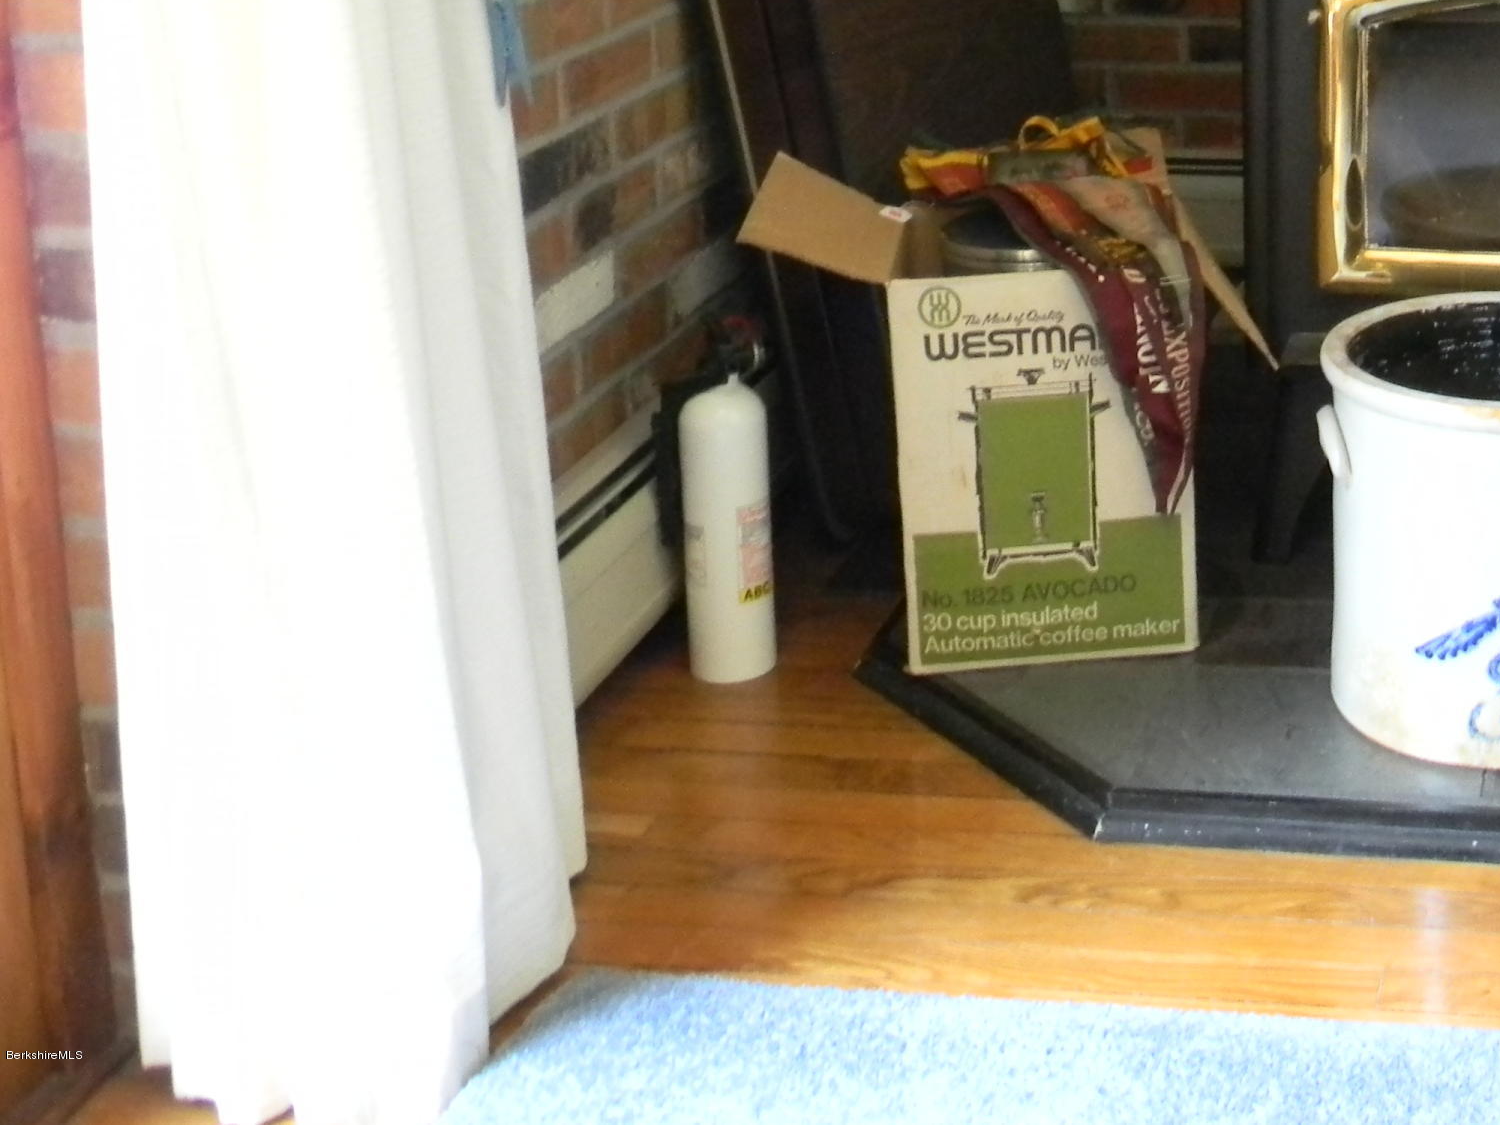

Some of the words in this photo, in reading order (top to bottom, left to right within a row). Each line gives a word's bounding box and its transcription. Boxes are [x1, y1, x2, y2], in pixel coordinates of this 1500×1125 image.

[1026, 309, 1064, 324] Quality
[923, 323, 1097, 362] WESTMA
[1052, 356, 1071, 371] by
[1074, 355, 1105, 367] Wes
[921, 588, 958, 608] No.
[964, 585, 1014, 606] 1825
[1021, 574, 1138, 603] AVOCADO
[923, 612, 952, 633] 30
[956, 614, 996, 634] cup
[1001, 600, 1099, 628] insulated
[924, 631, 1035, 654] Automatic
[1039, 625, 1108, 647] coffee
[1113, 618, 1181, 639] maker
